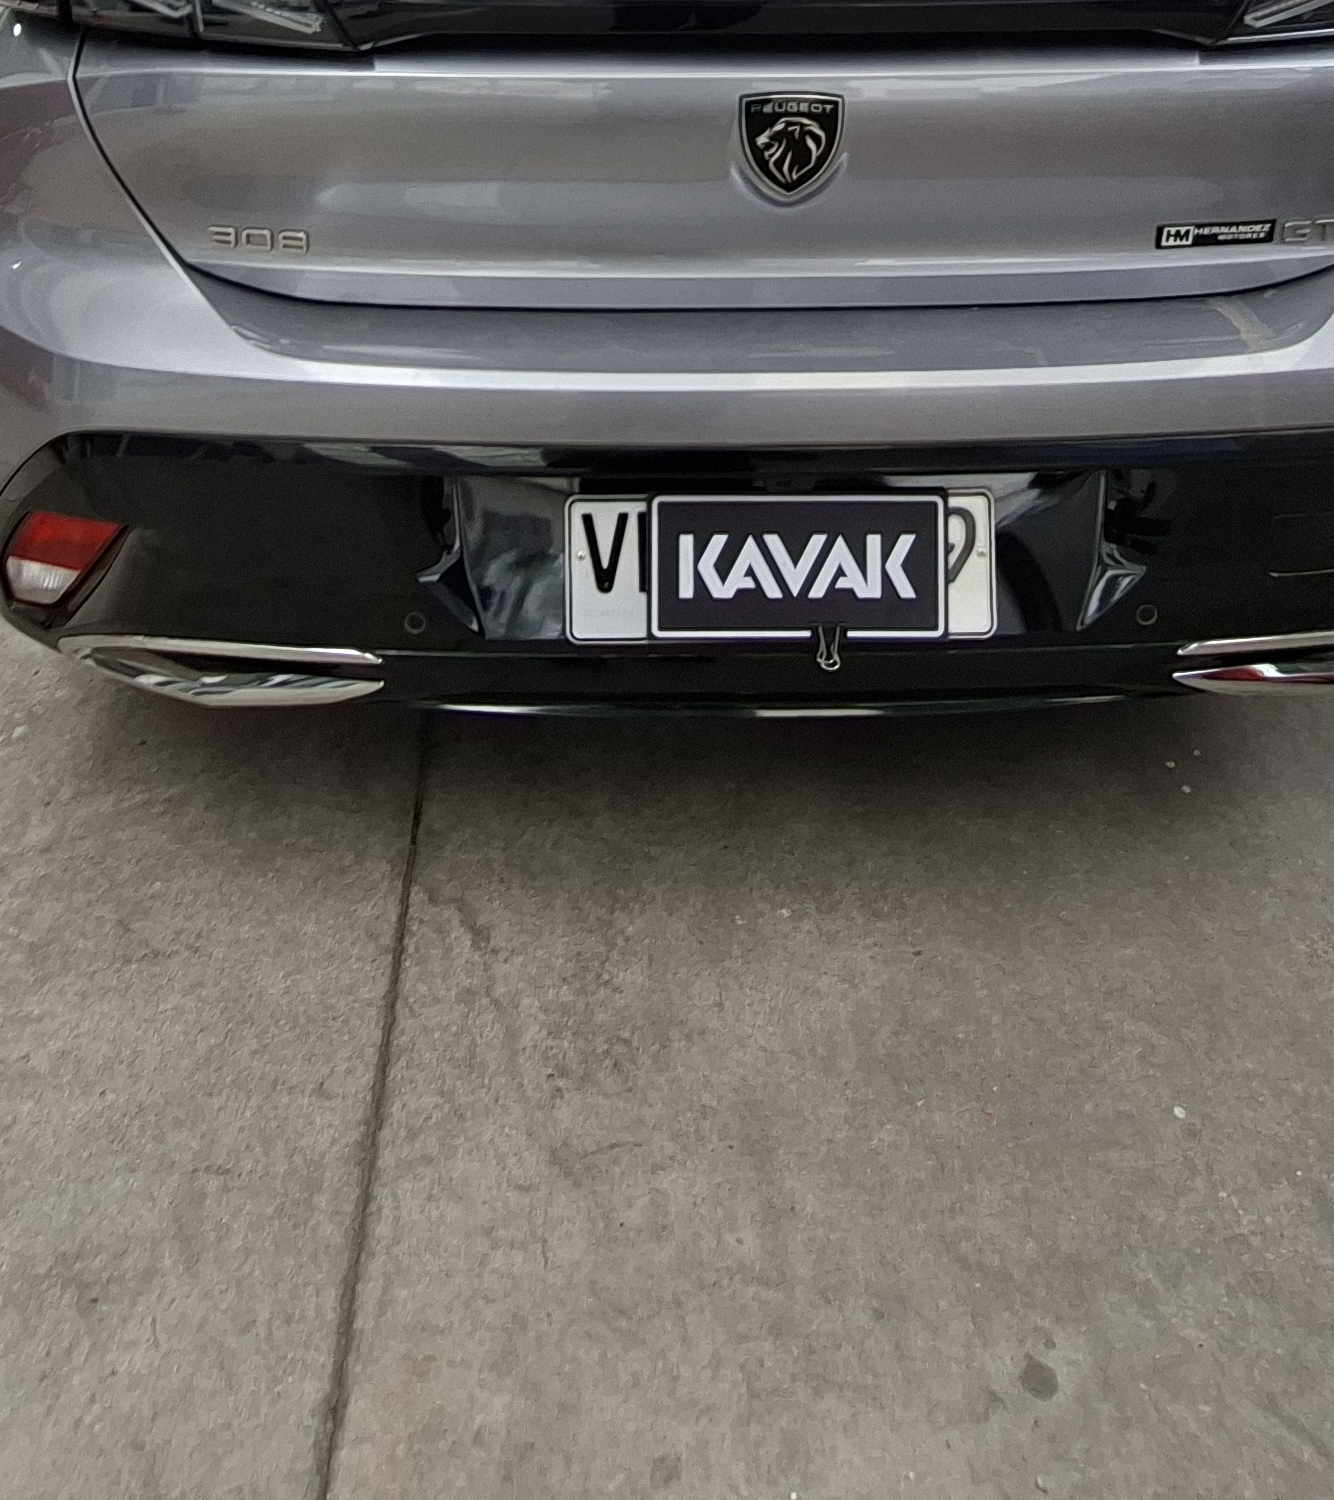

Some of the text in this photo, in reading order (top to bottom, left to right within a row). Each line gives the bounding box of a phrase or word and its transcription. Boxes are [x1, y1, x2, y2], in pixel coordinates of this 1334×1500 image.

[750, 101, 835, 114] PEUGEOT
[207, 225, 309, 256] 308
[1194, 223, 1272, 236] HERNANDEZ
[678, 533, 917, 599] KAVAK
